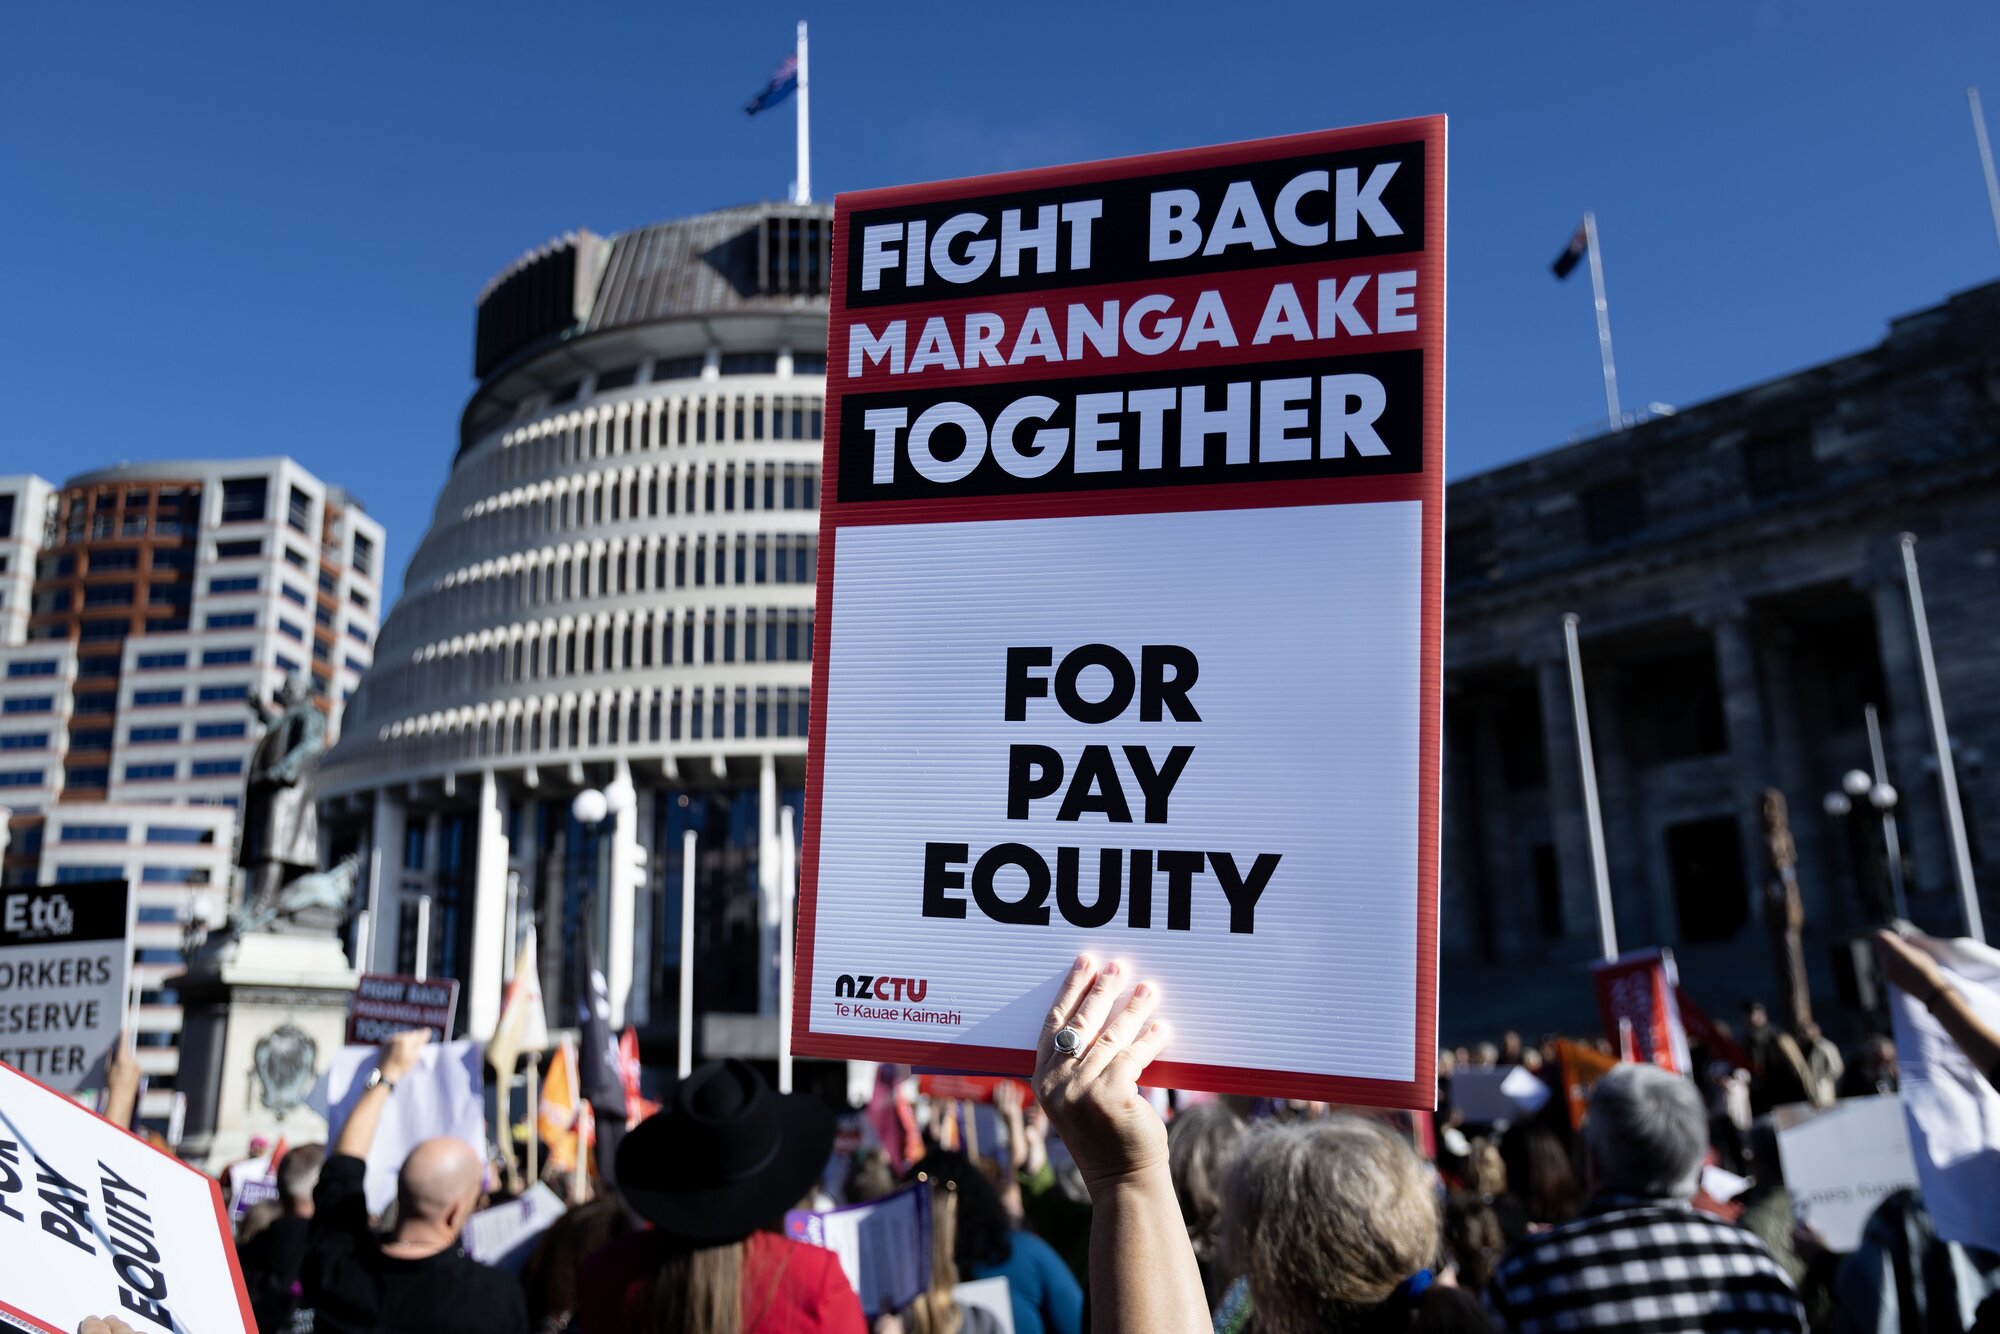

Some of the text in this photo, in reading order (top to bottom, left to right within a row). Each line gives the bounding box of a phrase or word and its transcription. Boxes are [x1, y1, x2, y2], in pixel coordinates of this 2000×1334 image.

[861, 161, 1405, 292] FIGHT BACK
[847, 270, 1418, 379] MARANGA AKE
[864, 373, 1391, 484] TOGETHER
[1004, 643, 1203, 725] FOR
[1006, 743, 1196, 824] PAY
[921, 841, 1283, 935] EQUITY
[835, 1002, 962, 1025] Te Kauae Kaimahi
[33, 1153, 97, 1257] PAY
[97, 1158, 174, 1331] EQUITY
